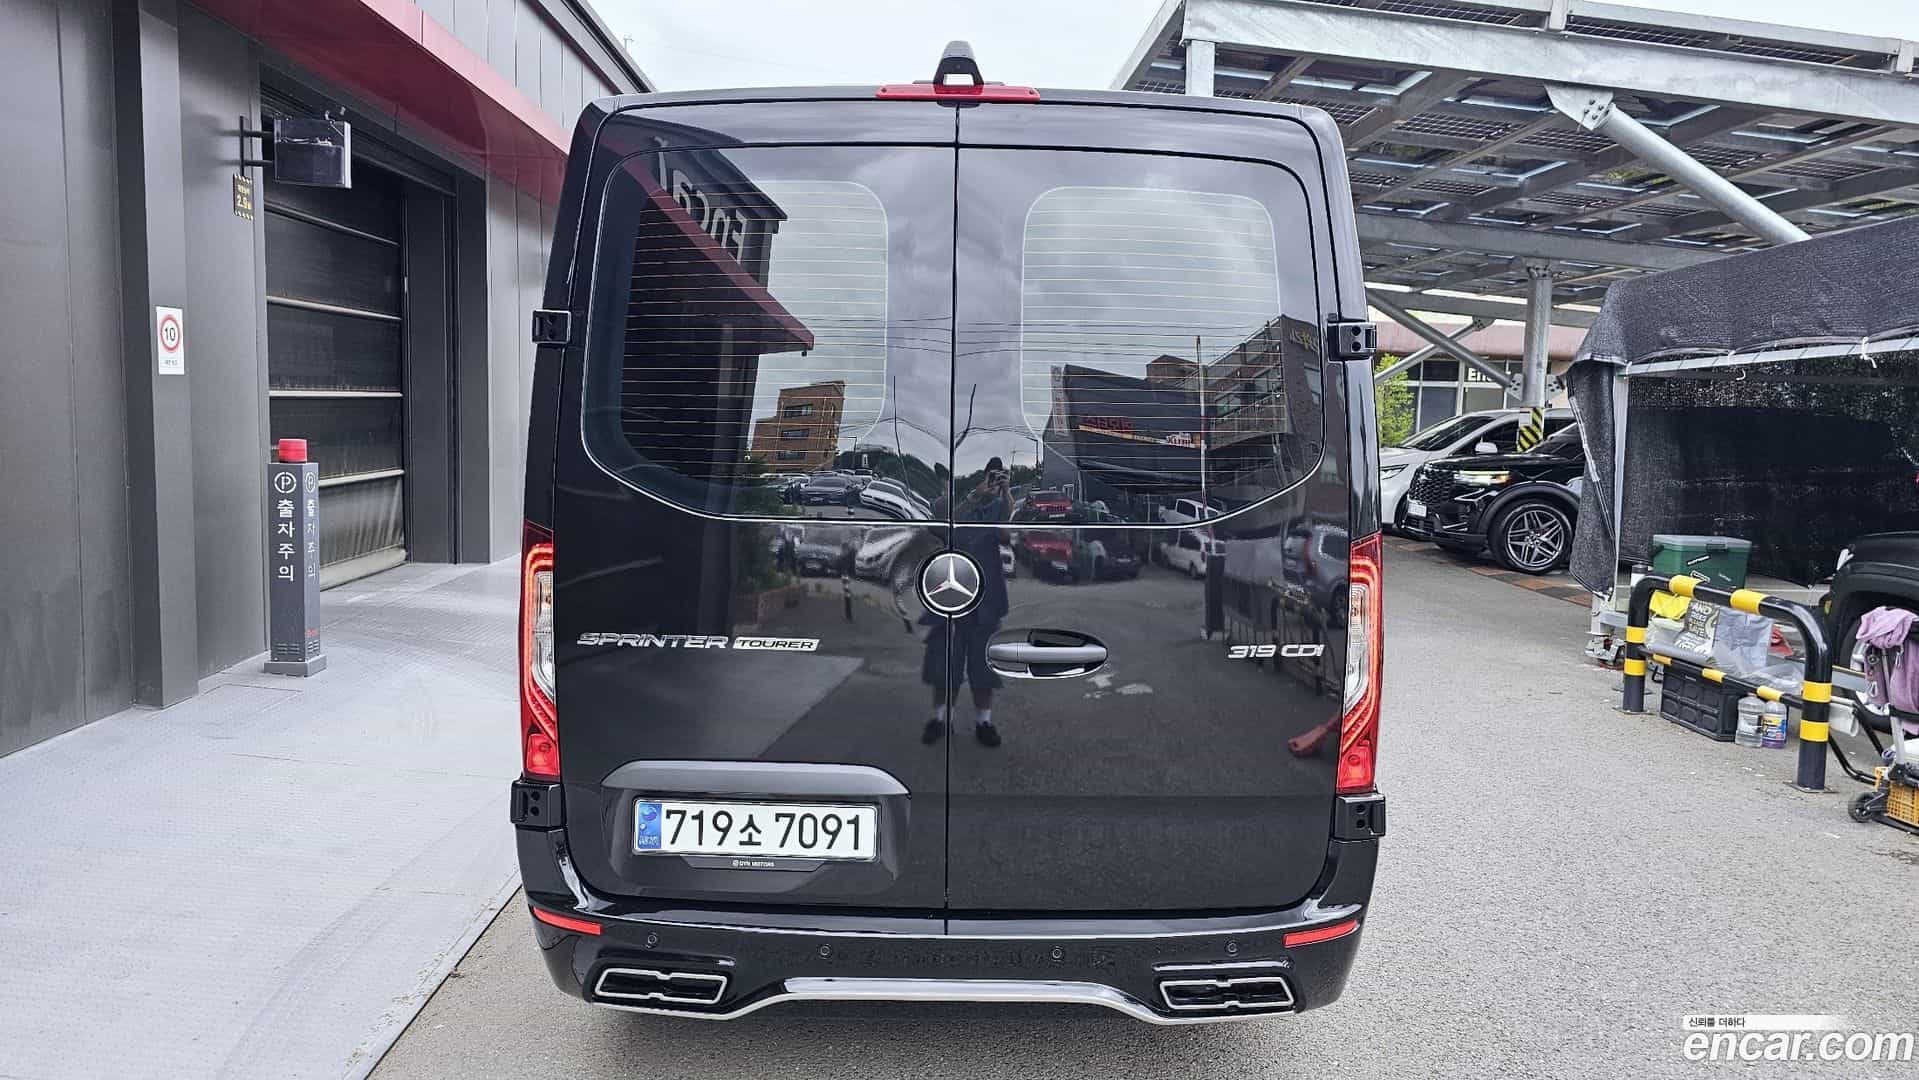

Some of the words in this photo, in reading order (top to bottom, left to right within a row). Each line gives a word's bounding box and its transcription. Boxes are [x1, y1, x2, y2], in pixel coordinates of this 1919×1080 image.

[165, 327, 176, 341] 10
[577, 633, 729, 649] SPRINTER
[738, 638, 815, 650] TOURER
[1228, 644, 1277, 659] 319
[1281, 644, 1325, 657] CDI
[665, 809, 762, 846] 719소
[775, 813, 860, 850] 7091
